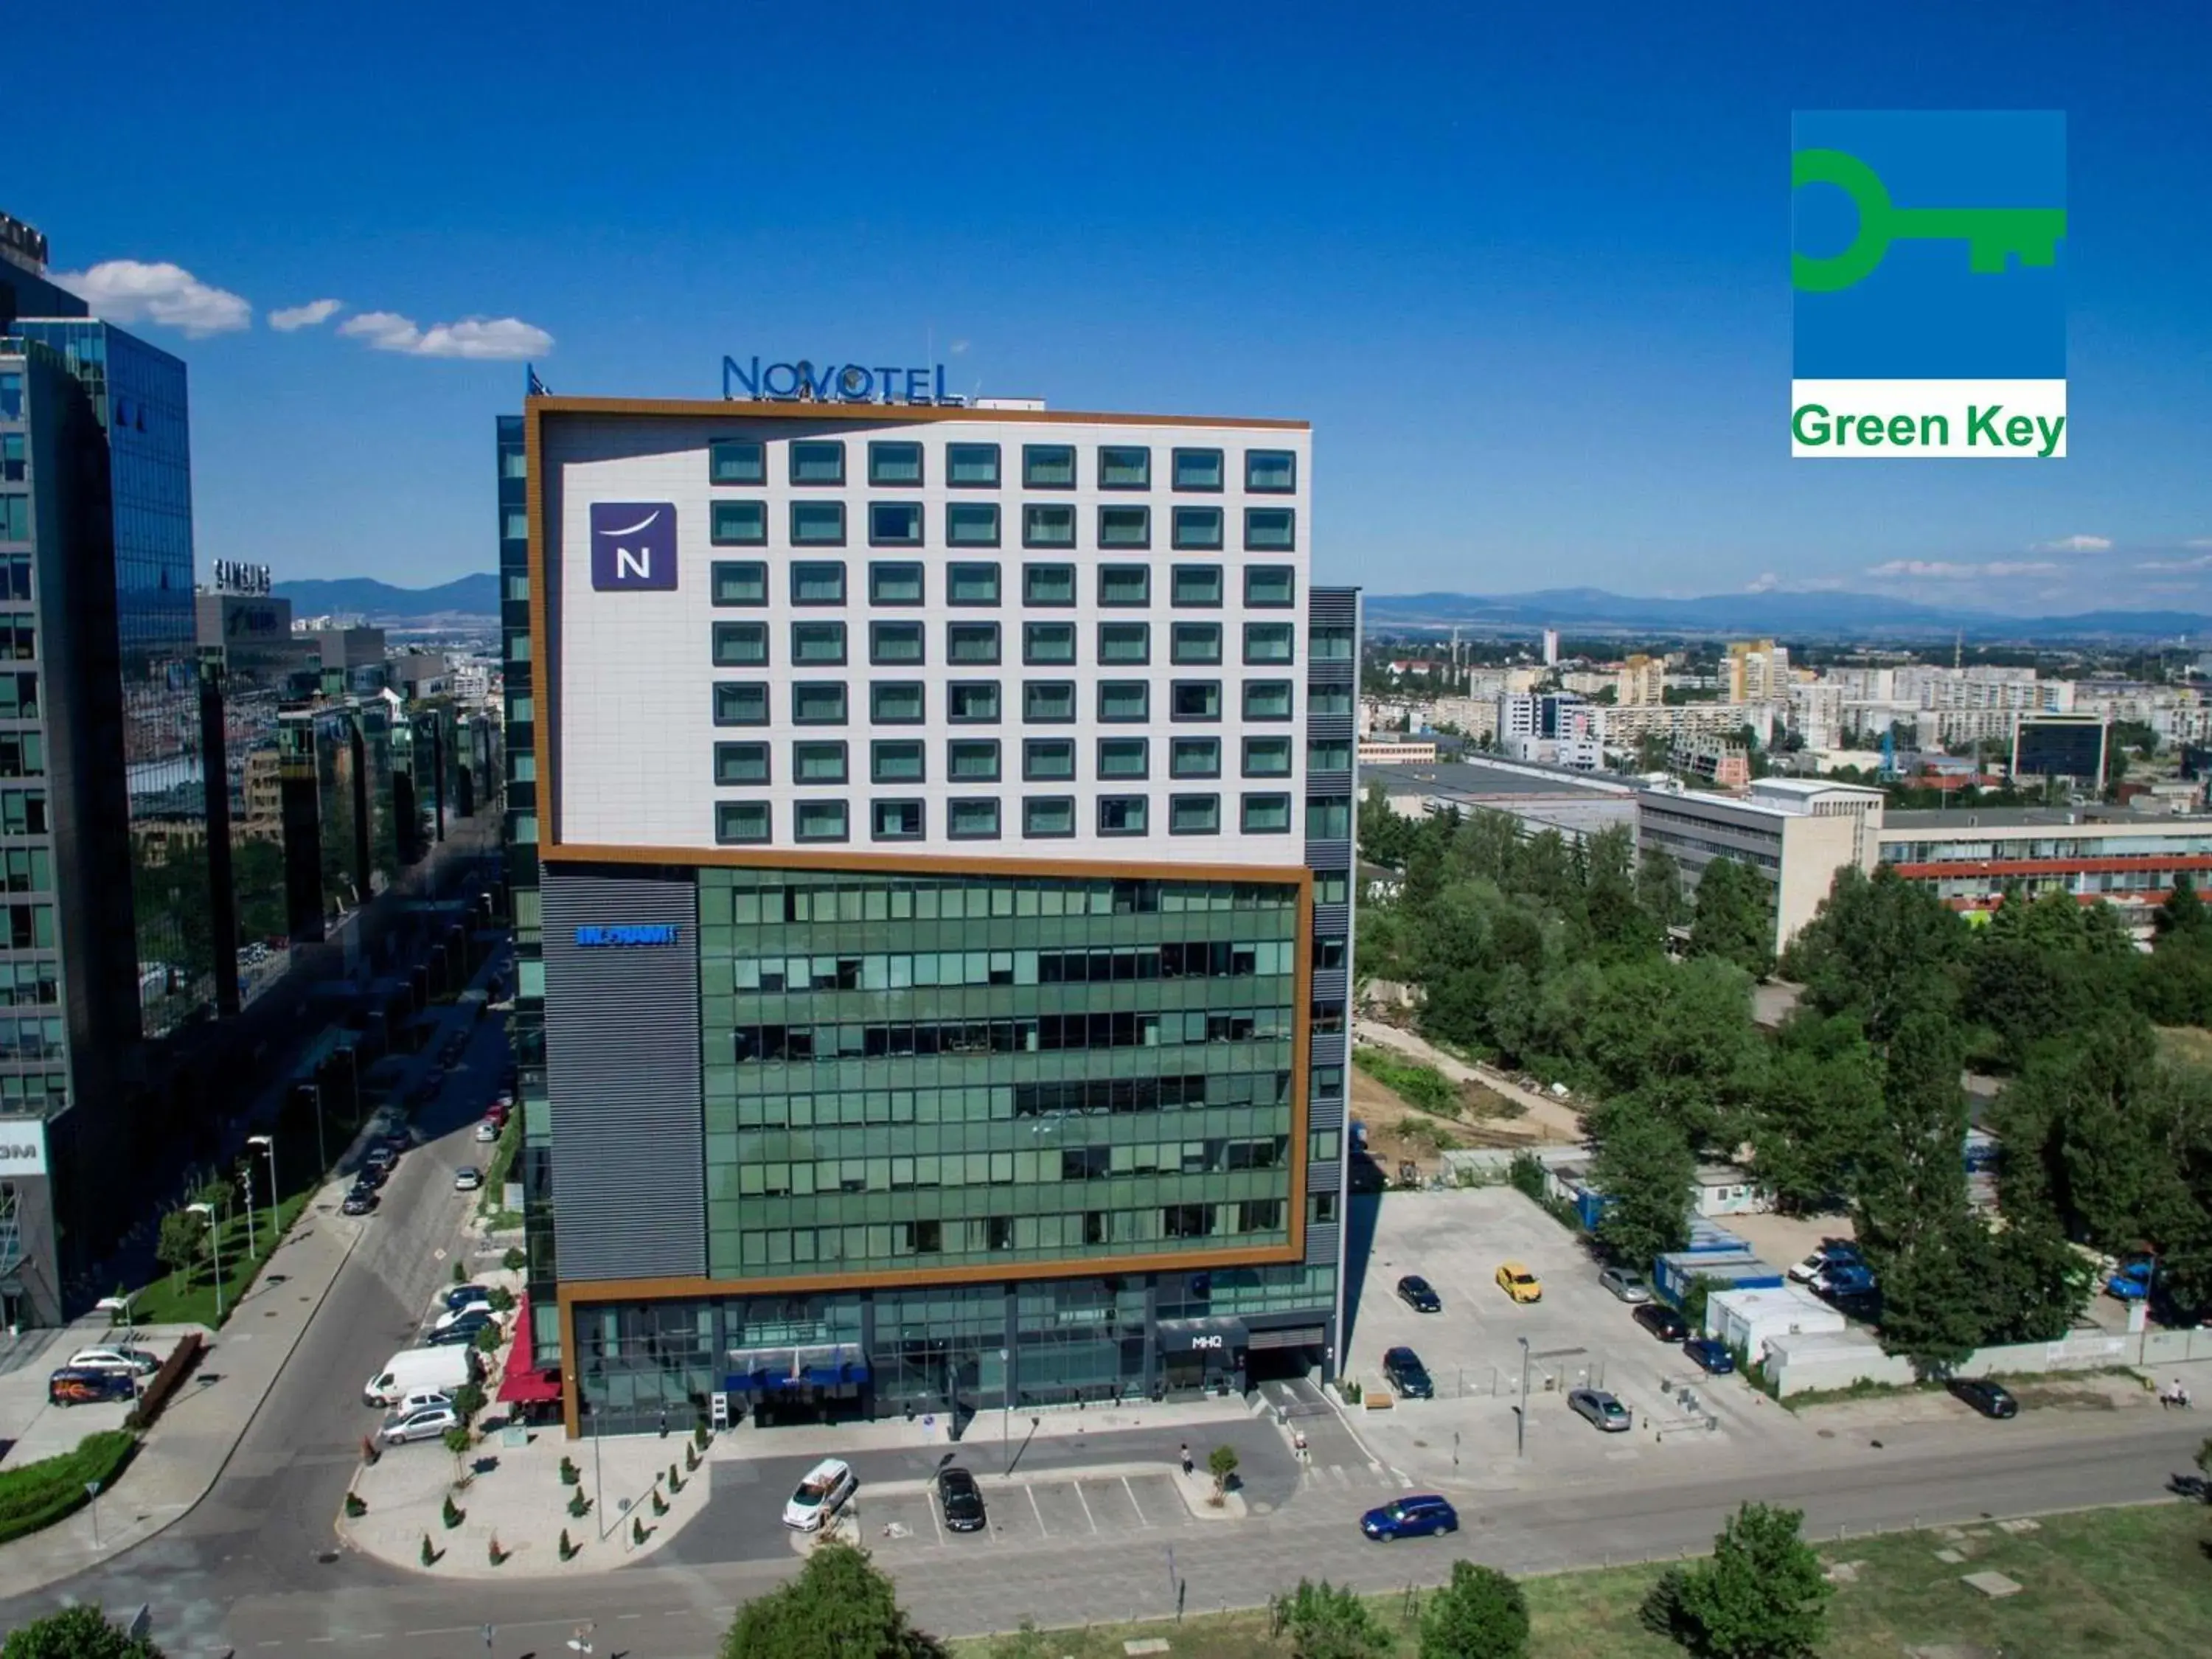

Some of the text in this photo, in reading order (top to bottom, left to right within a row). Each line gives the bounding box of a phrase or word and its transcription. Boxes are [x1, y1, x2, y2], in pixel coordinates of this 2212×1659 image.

[723, 355, 964, 405] NOVOTEL
[215, 559, 270, 594] SAMSUNG
[617, 547, 650, 579] N
[1192, 1335, 1222, 1349] MHQ
